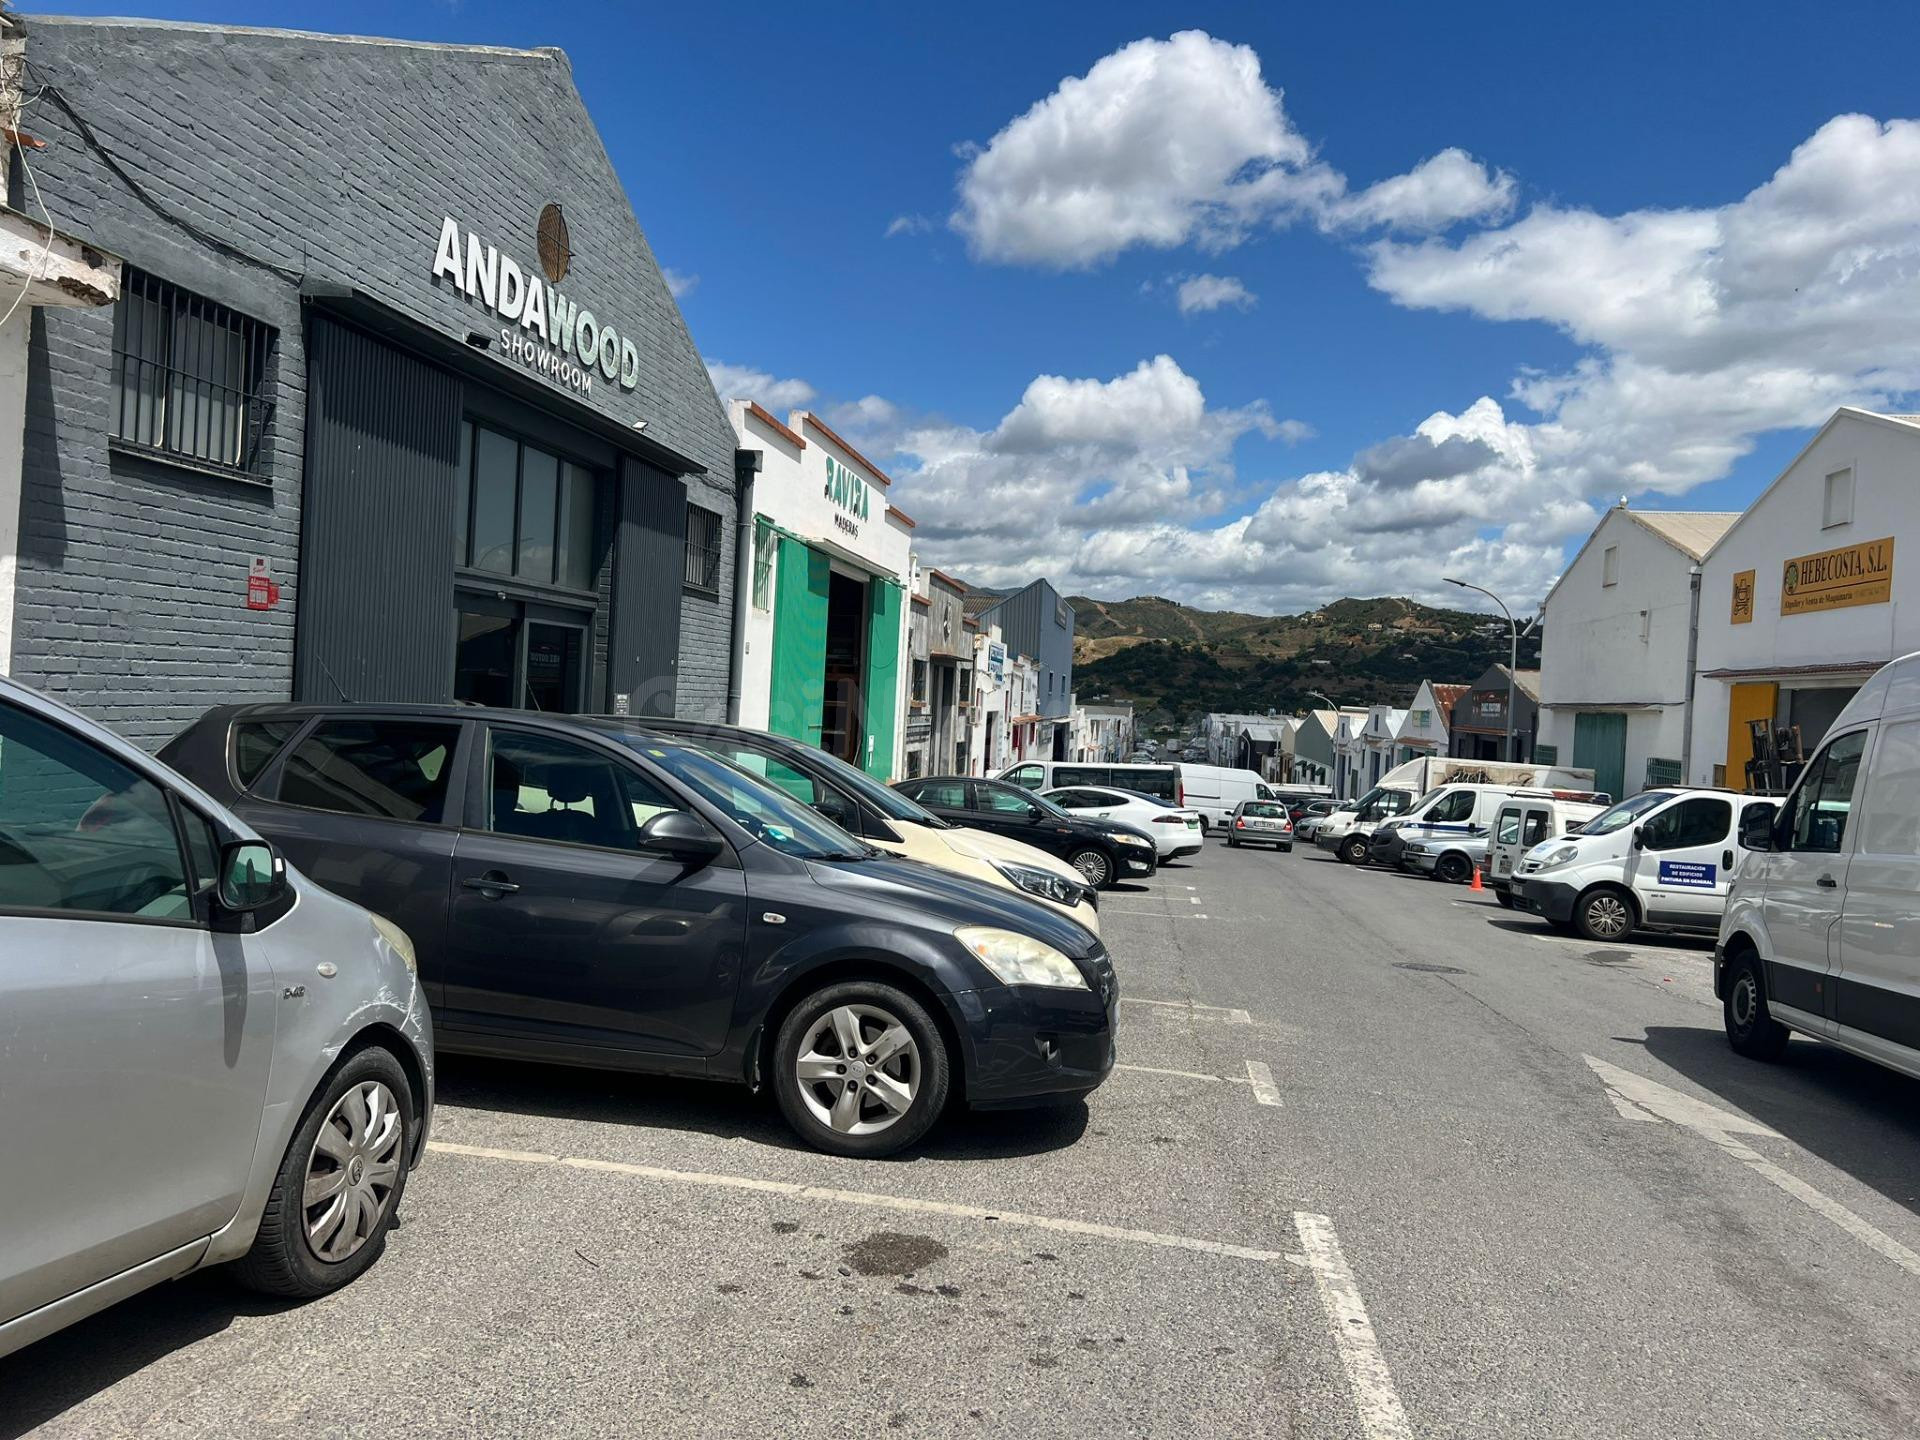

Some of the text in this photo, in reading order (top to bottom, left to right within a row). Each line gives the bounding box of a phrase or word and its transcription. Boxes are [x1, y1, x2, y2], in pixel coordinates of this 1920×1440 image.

[432, 216, 639, 389] ANDAWOOD
[500, 329, 592, 393] SHOWROOM
[834, 512, 858, 540] MADERAS
[1867, 545, 1888, 573] S.L.
